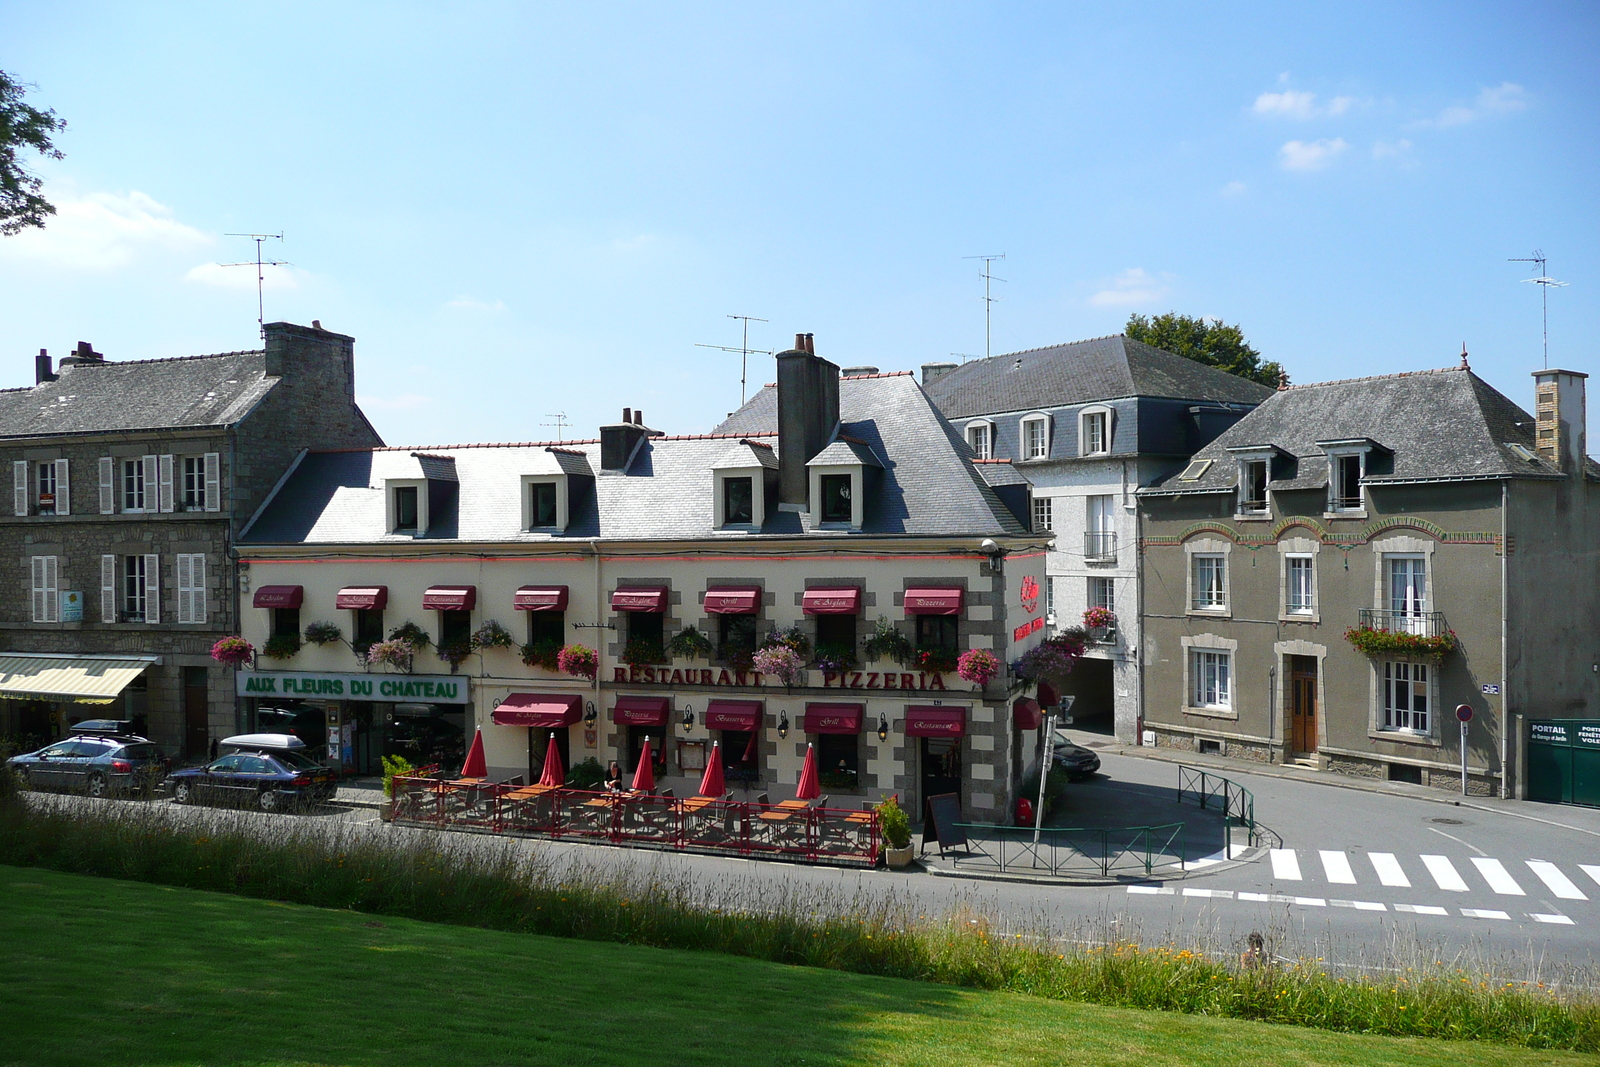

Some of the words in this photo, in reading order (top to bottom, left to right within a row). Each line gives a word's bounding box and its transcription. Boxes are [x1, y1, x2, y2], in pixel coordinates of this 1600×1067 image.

[719, 597, 738, 607] Grill
[915, 598, 947, 607] Pizzeria
[613, 667, 764, 687] RESTAURANT
[823, 671, 947, 691] PIZZERIA
[245, 677, 276, 693] AUX
[282, 678, 344, 695] FLEURS
[350, 680, 373, 697] DU
[379, 680, 458, 699] CHATEAU
[623, 709, 650, 719] Pizzeria
[714, 714, 746, 724] Brasserie
[819, 717, 840, 727] Grill
[913, 721, 953, 730] Restaurant
[1532, 724, 1566, 734] PORTAIL
